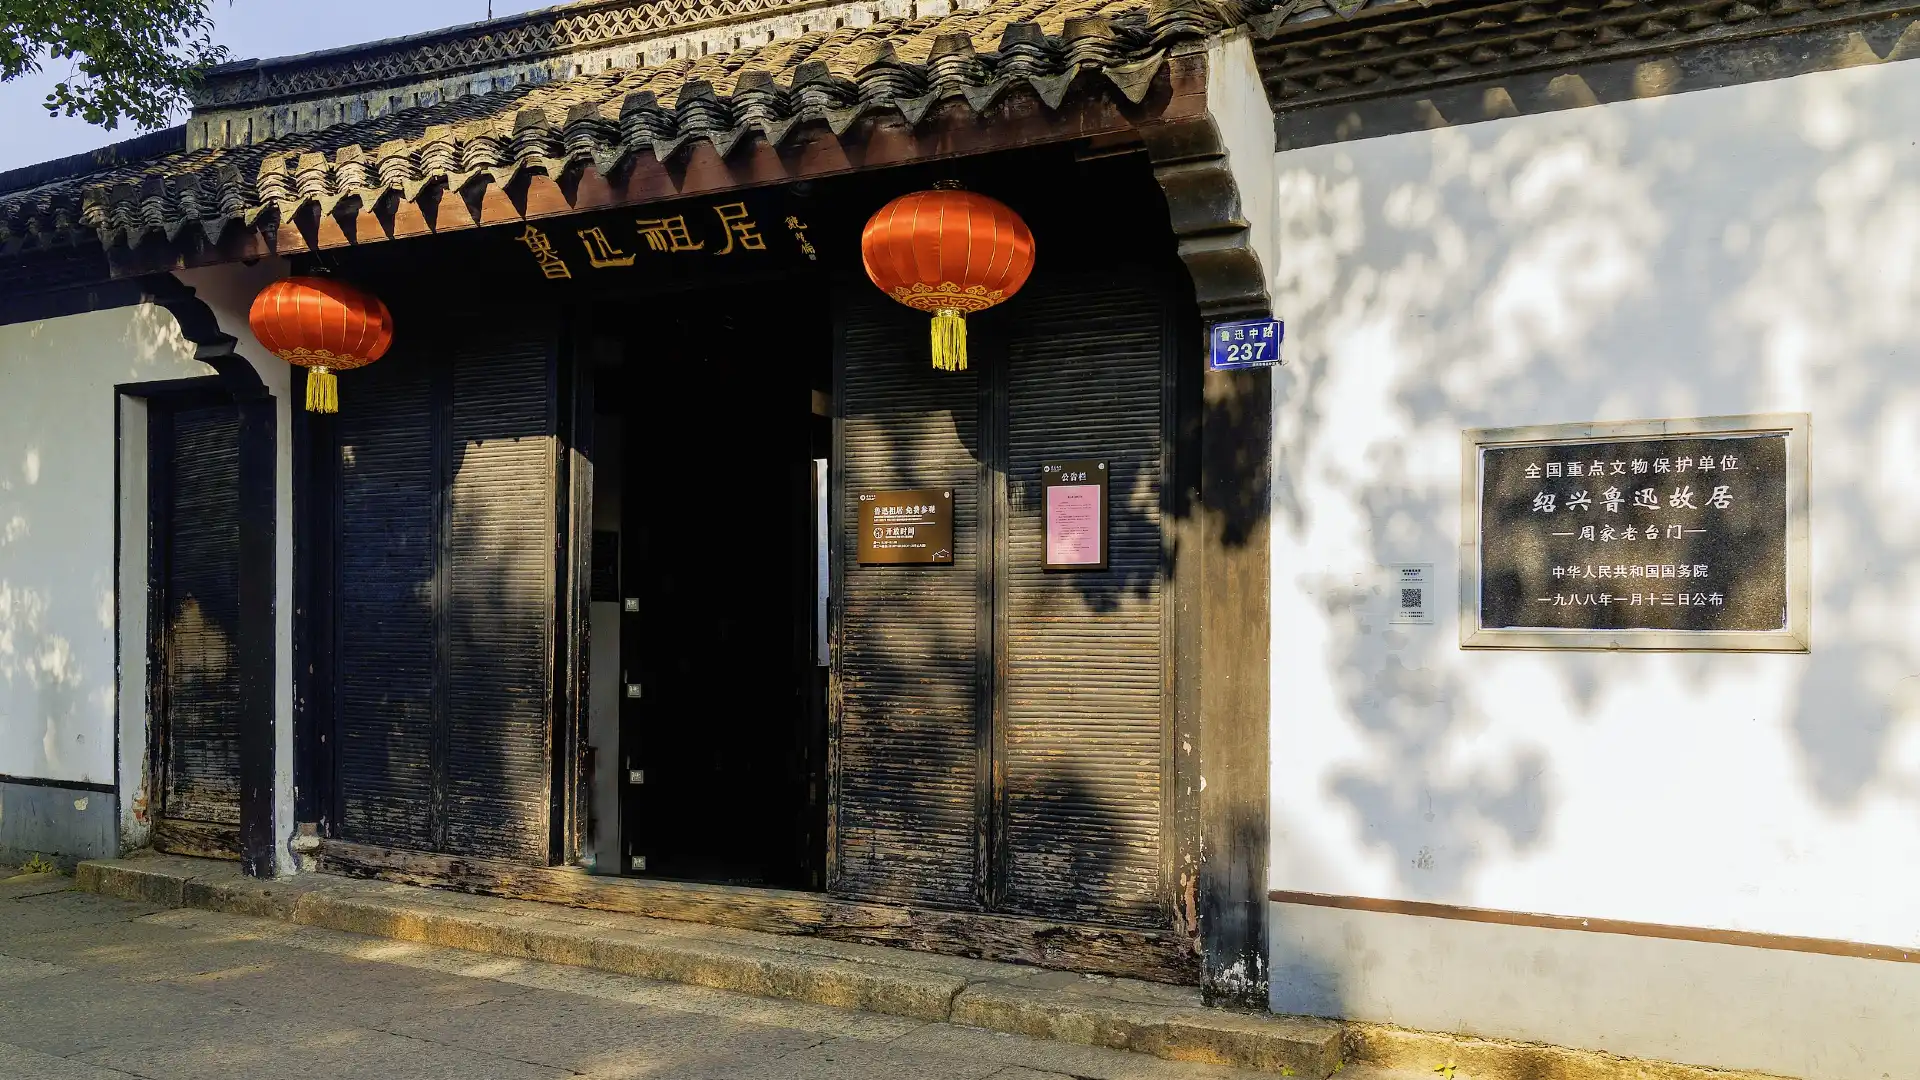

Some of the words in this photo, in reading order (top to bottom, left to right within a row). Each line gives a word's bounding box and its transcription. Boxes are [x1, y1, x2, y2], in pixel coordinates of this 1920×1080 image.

[1221, 323, 1273, 342] 鲁迅中路
[1227, 342, 1267, 361] 237
[1061, 472, 1087, 481] 公告栏
[1524, 455, 1739, 479] 全国重点文物保护单位
[1532, 485, 1734, 513] 绍兴鲁迅故居
[1552, 564, 1709, 579] 中华人民共和国国务院
[1537, 592, 1724, 607] 一九八八年一月十三日公布
